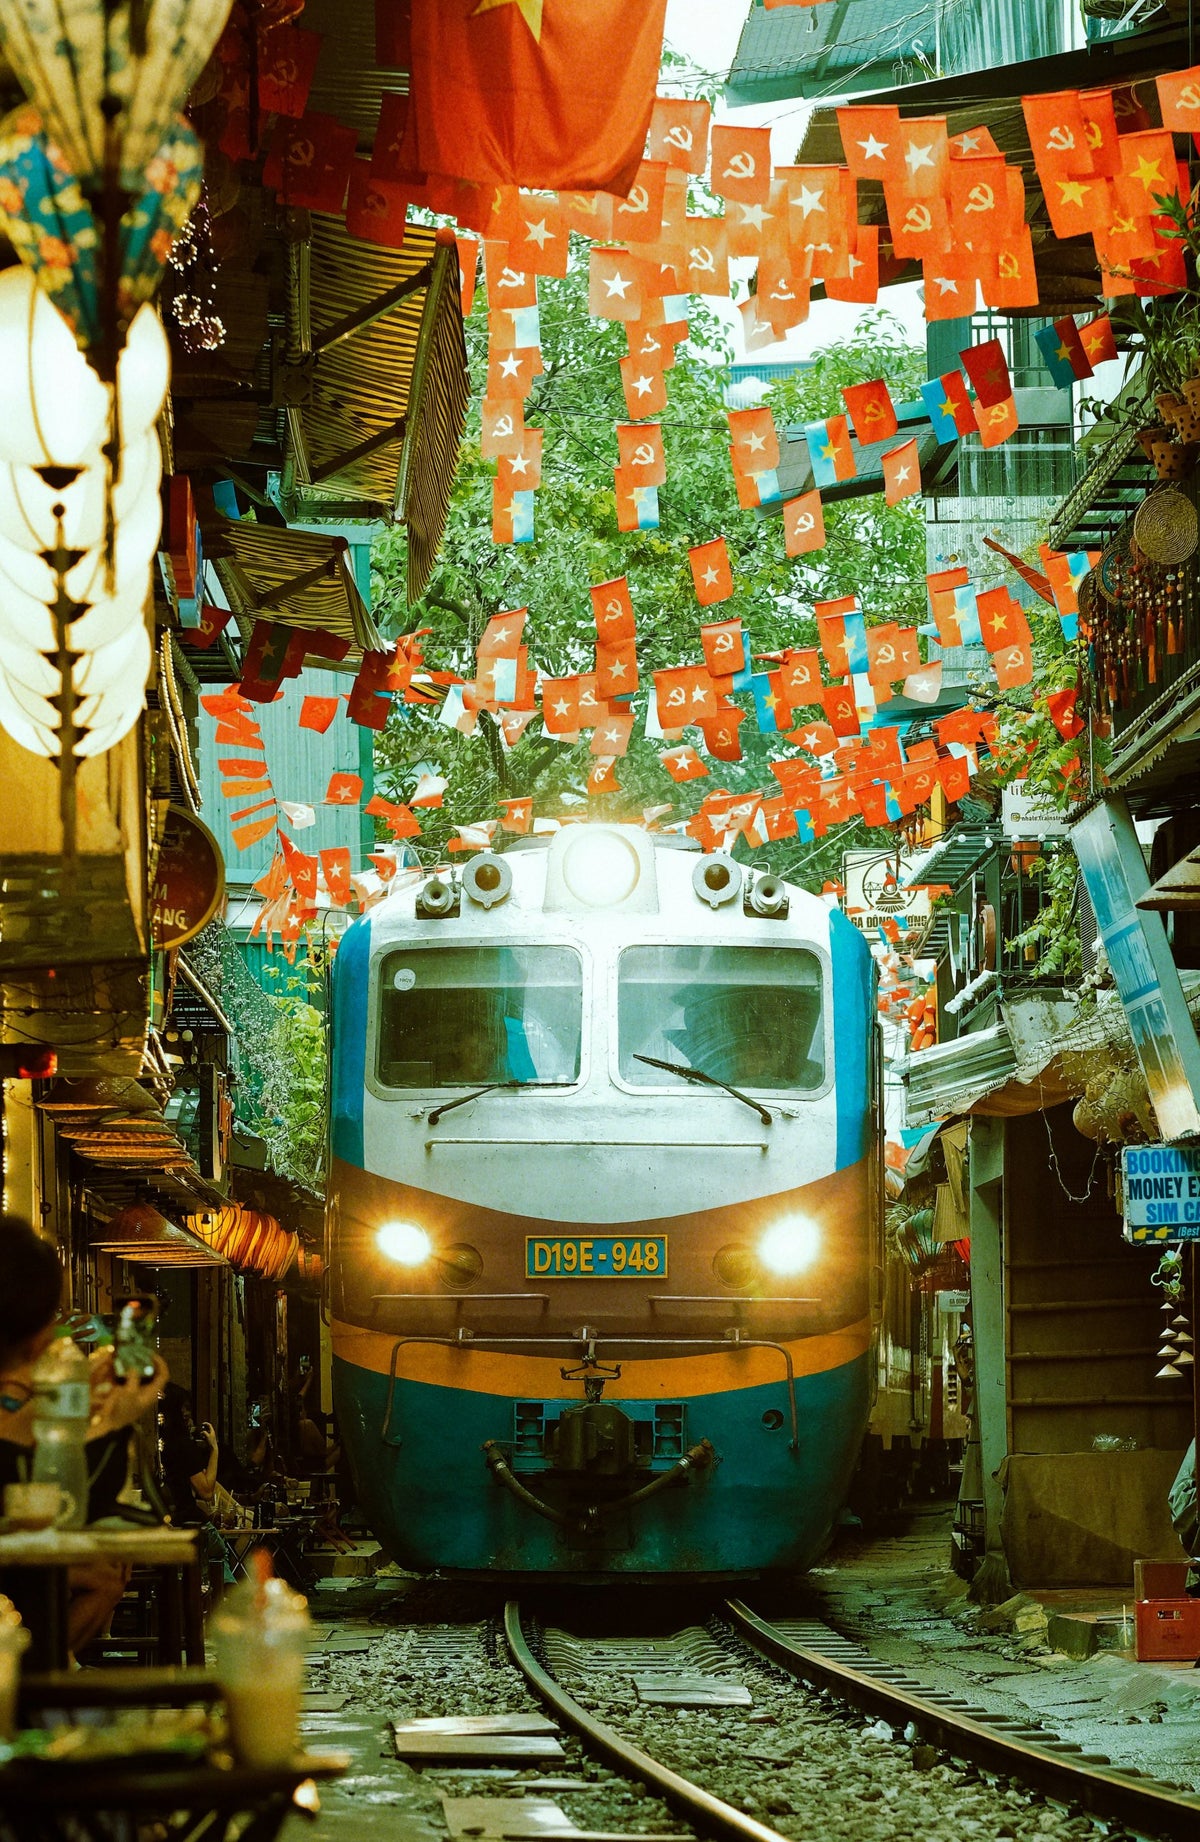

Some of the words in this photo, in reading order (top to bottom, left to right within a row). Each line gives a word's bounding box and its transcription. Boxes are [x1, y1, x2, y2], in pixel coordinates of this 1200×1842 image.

[152, 883, 168, 901] M
[152, 903, 188, 931] ÀNG
[851, 916, 863, 928] GA
[1127, 1148, 1200, 1175] BOOKING
[1128, 1176, 1183, 1201] MONEY
[1188, 1176, 1200, 1198] E
[1145, 1202, 1179, 1224] SIM
